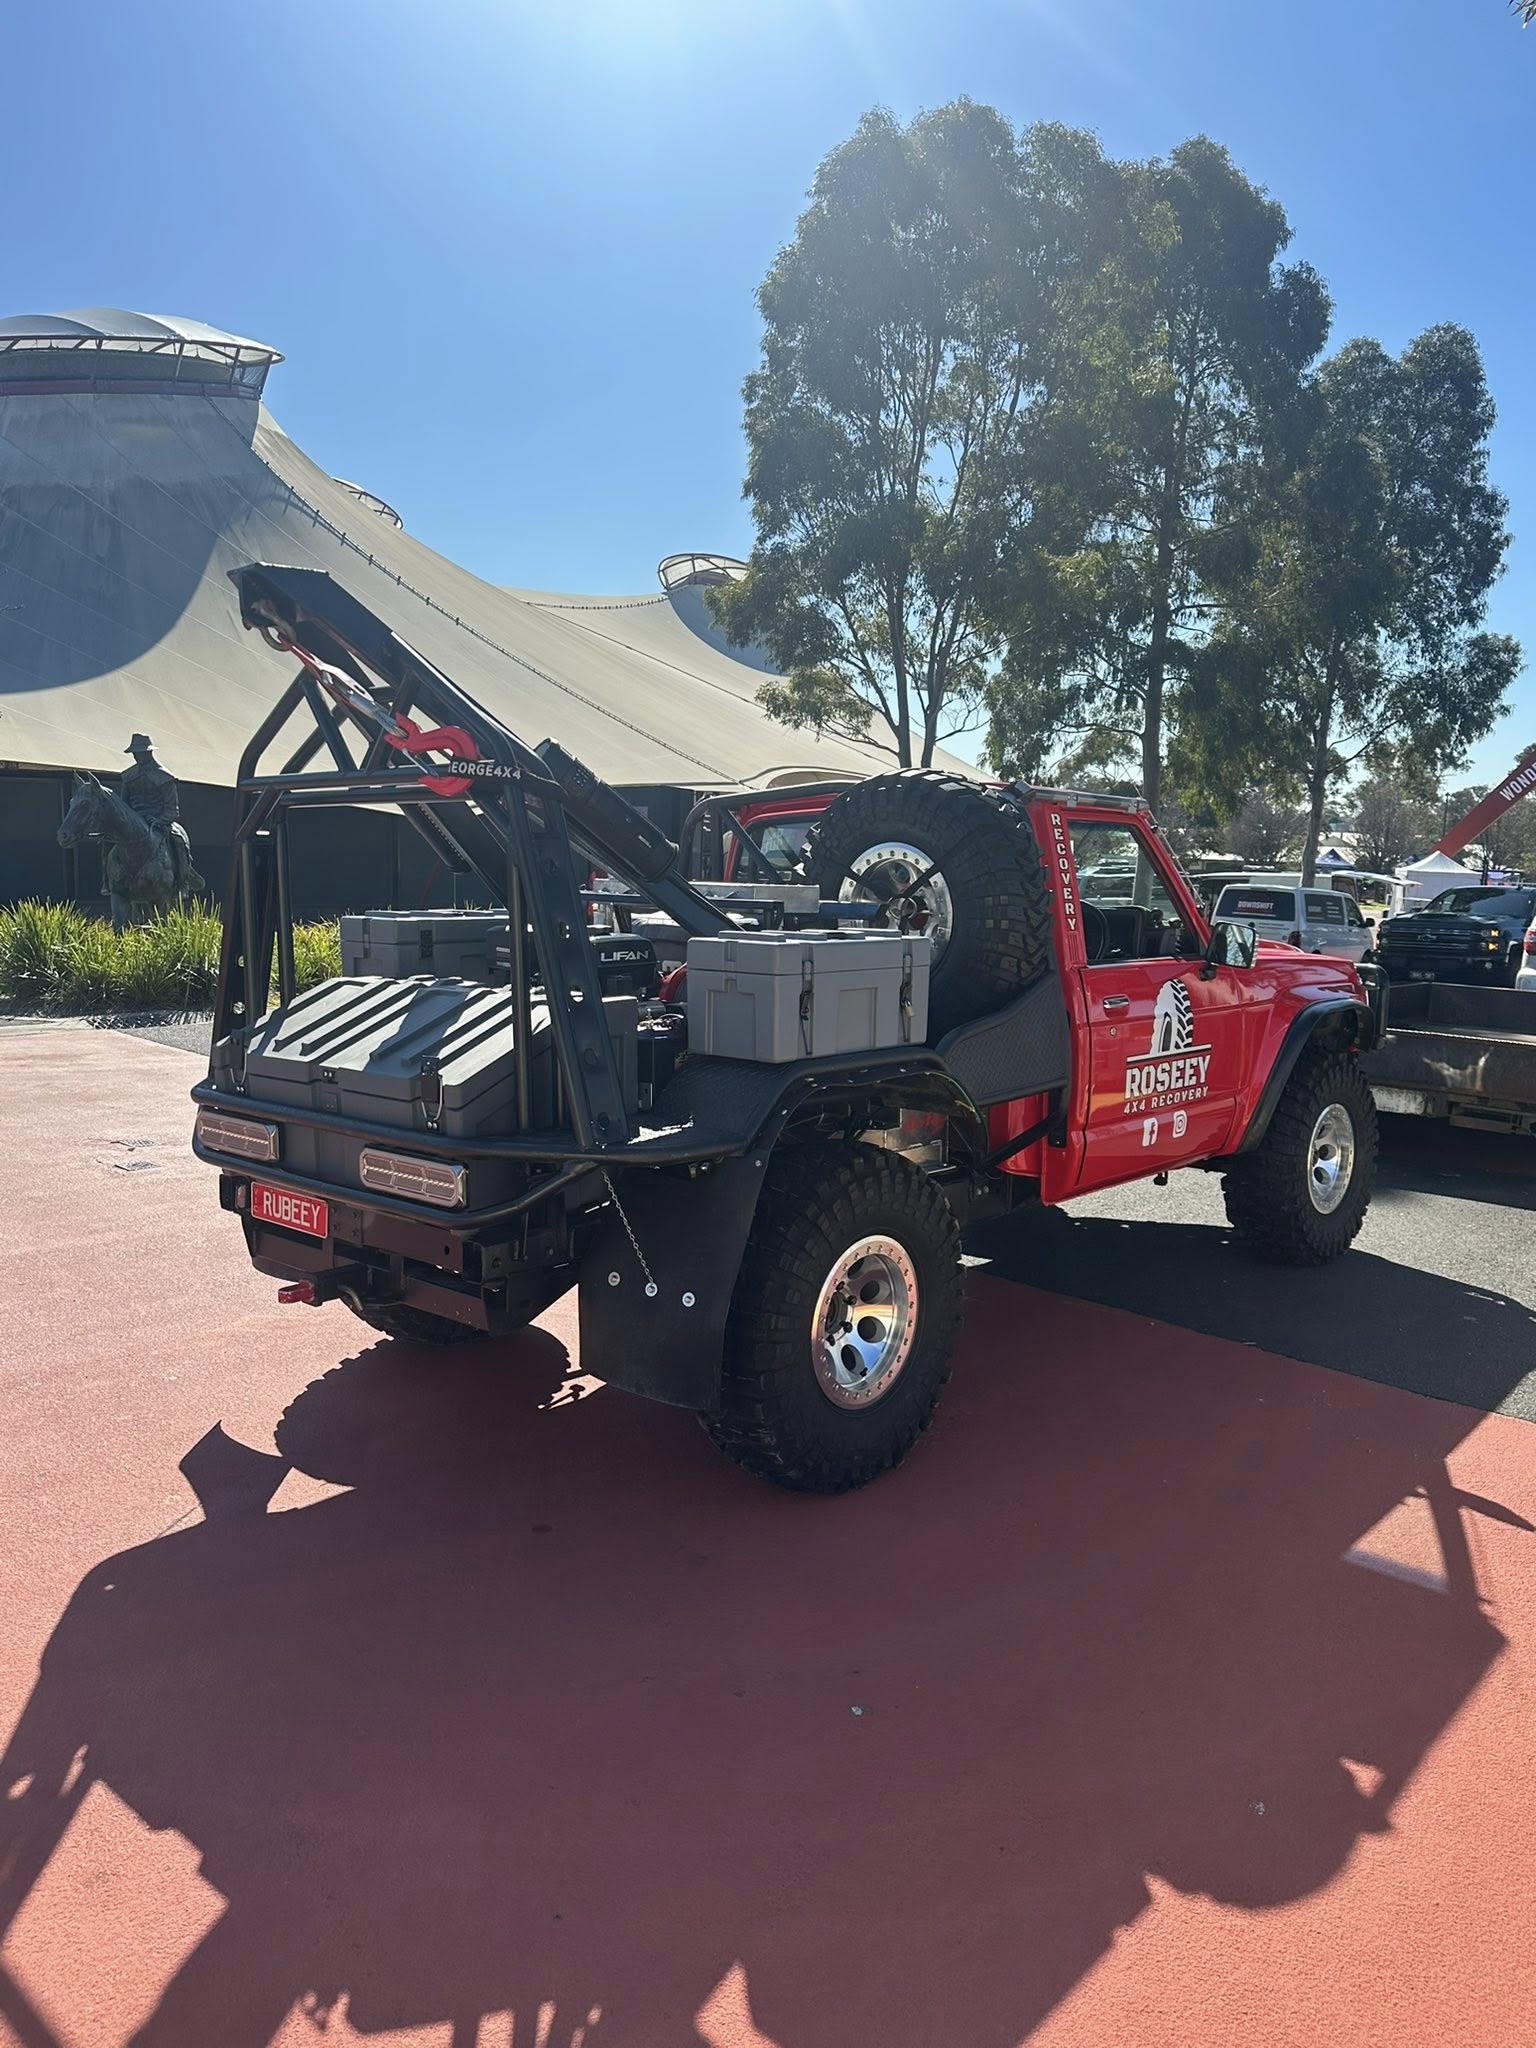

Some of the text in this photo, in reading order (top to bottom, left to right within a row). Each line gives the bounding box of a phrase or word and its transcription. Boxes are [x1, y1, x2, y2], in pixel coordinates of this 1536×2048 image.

[1051, 813, 1076, 930] RECOVERY
[601, 950, 649, 962] LIFAN
[1125, 1055, 1211, 1099] ROSEEY
[1124, 1086, 1209, 1114] 4X4 RECOVERY
[263, 1190, 321, 1230] RUBEEY
